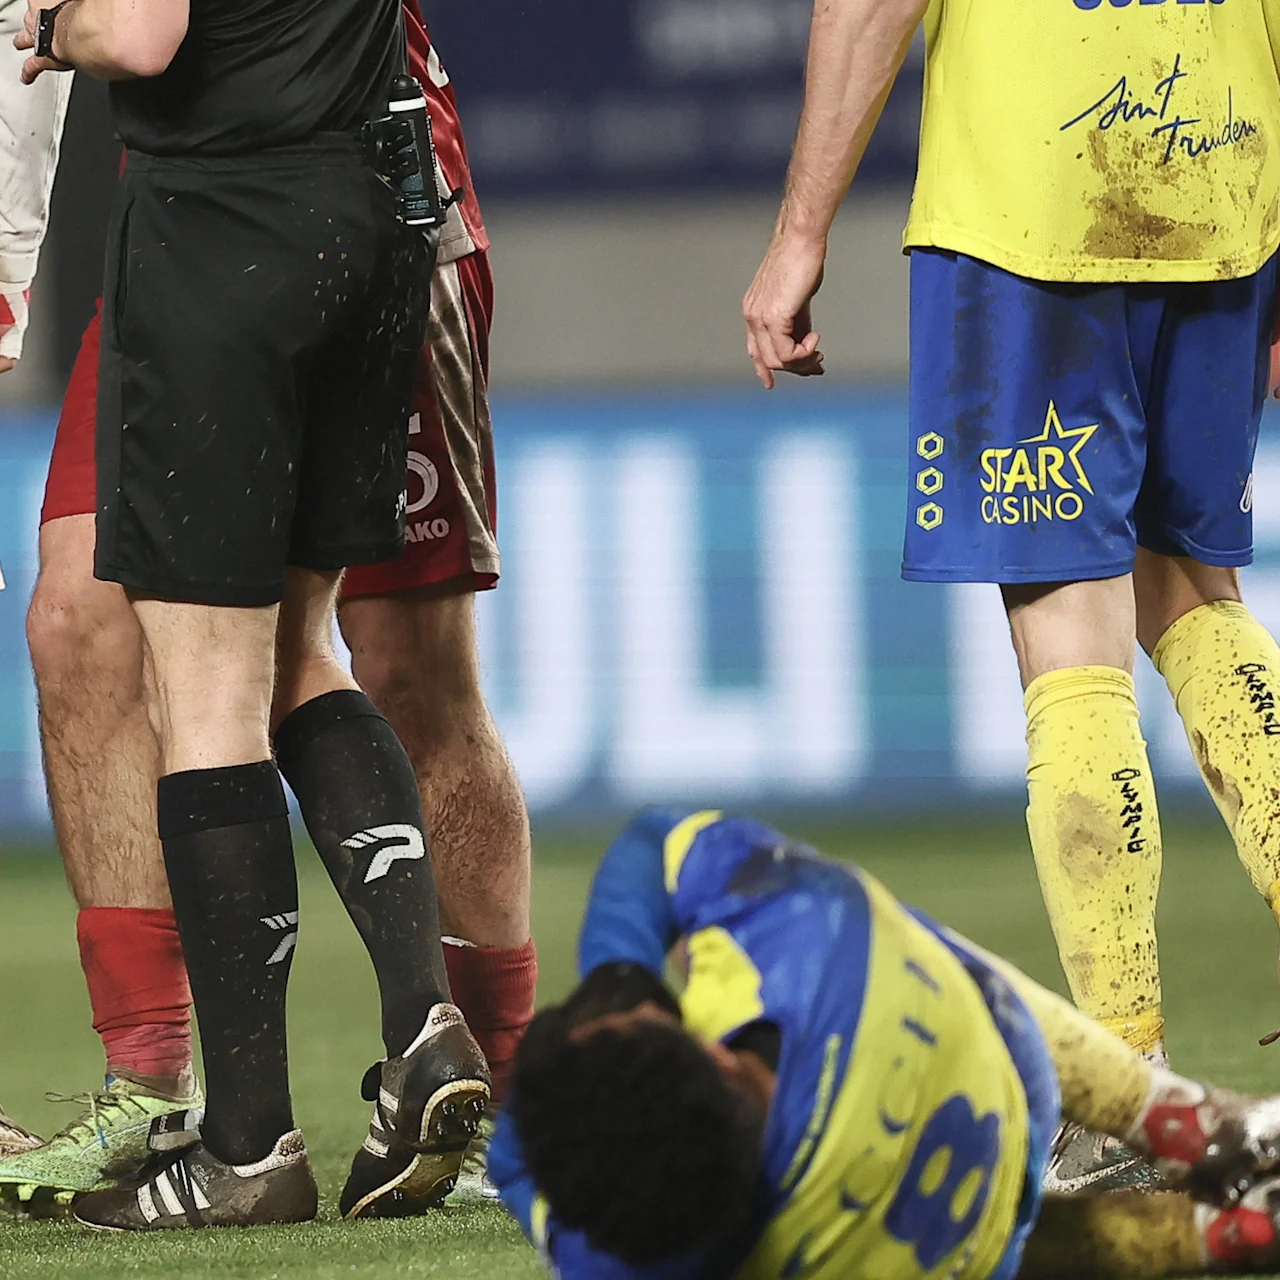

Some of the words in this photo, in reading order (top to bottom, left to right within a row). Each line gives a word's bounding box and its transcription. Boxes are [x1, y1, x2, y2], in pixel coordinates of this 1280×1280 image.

[979, 446, 1074, 494] STAR
[980, 491, 1085, 525] CASINO
[403, 517, 450, 544] AKO
[884, 1092, 1001, 1272] 8
